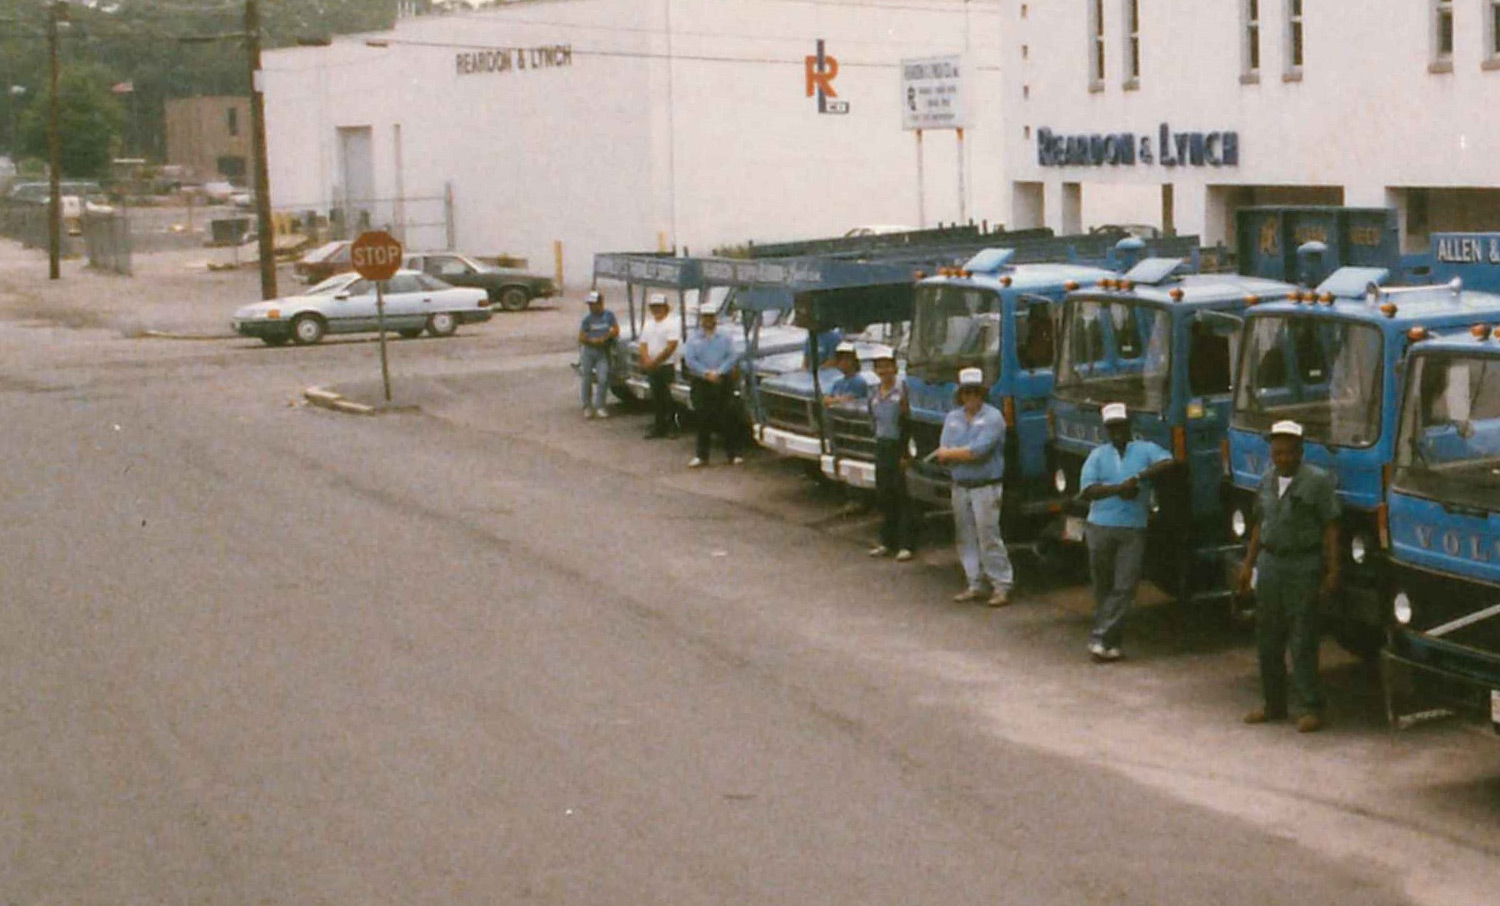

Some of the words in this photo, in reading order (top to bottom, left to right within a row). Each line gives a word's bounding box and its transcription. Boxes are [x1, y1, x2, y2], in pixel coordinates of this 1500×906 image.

[530, 44, 571, 69] LYNCH
[353, 245, 400, 266] STOP
[1437, 238, 1482, 263] ALLEN
[1489, 238, 1500, 263] &
